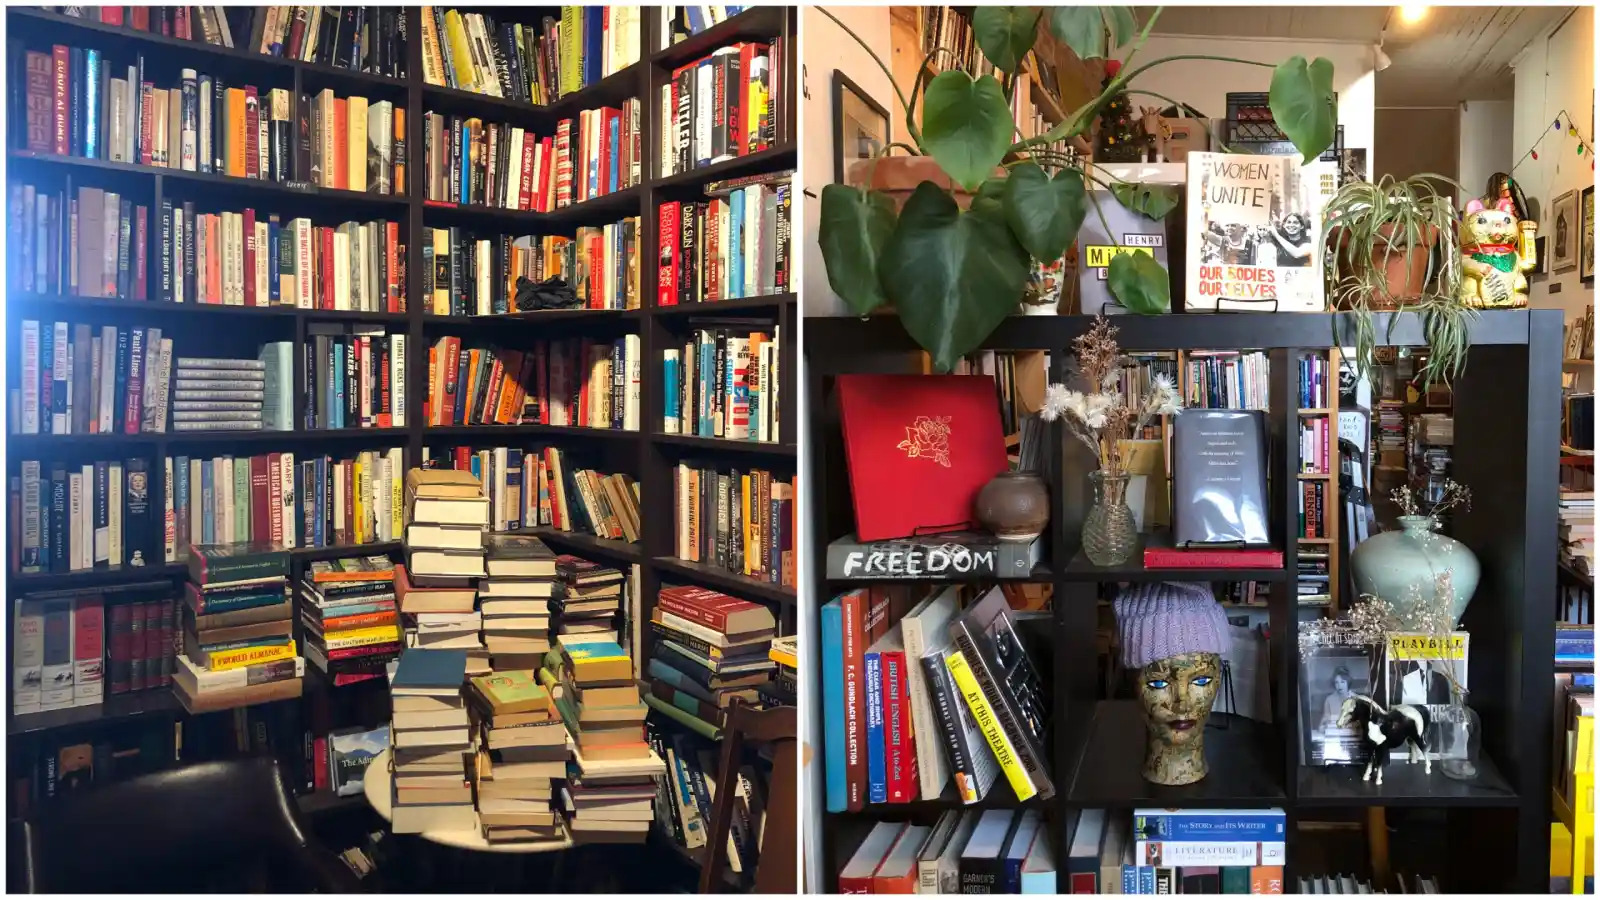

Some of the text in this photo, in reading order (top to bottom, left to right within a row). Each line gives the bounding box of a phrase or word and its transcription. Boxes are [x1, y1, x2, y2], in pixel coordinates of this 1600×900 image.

[680, 94, 691, 149] HITLER
[524, 146, 532, 173] URBAN
[1214, 161, 1270, 181] WOMEN
[1212, 185, 1264, 208] UNITE
[684, 205, 694, 248] DARK SUN
[1127, 236, 1160, 244] HENRY
[665, 265, 673, 286] DARK
[1200, 266, 1276, 282] OUR BODIES
[119, 332, 128, 348] 102
[131, 330, 143, 378] Fault Lines
[157, 351, 171, 421] Rachel Maddow
[725, 359, 733, 395] STAMPED
[271, 462, 281, 496] AMERICAN
[284, 456, 293, 484] SHARP
[718, 482, 726, 524] DOPESICK
[844, 551, 994, 577] FREEDOM
[222, 647, 282, 666] WORLD ALMANAC
[1392, 638, 1464, 650] PLAYBILL
[888, 661, 898, 700] BRITISH
[956, 635, 986, 678] GUINNESS
[982, 680, 1004, 711] WORLD
[868, 693, 876, 728] DICTIONARY
[891, 704, 901, 746] ENGLISH
[937, 692, 964, 769] HUMANS OF NEW YORK
[967, 691, 1013, 768] AT THIS THEATRE
[849, 721, 857, 765] COLLECTION
[342, 759, 357, 768] The
[893, 757, 900, 765] to
[893, 766, 902, 781] Zed
[1174, 847, 1238, 855] LITERATURE
[963, 873, 995, 884] GARNER'S
